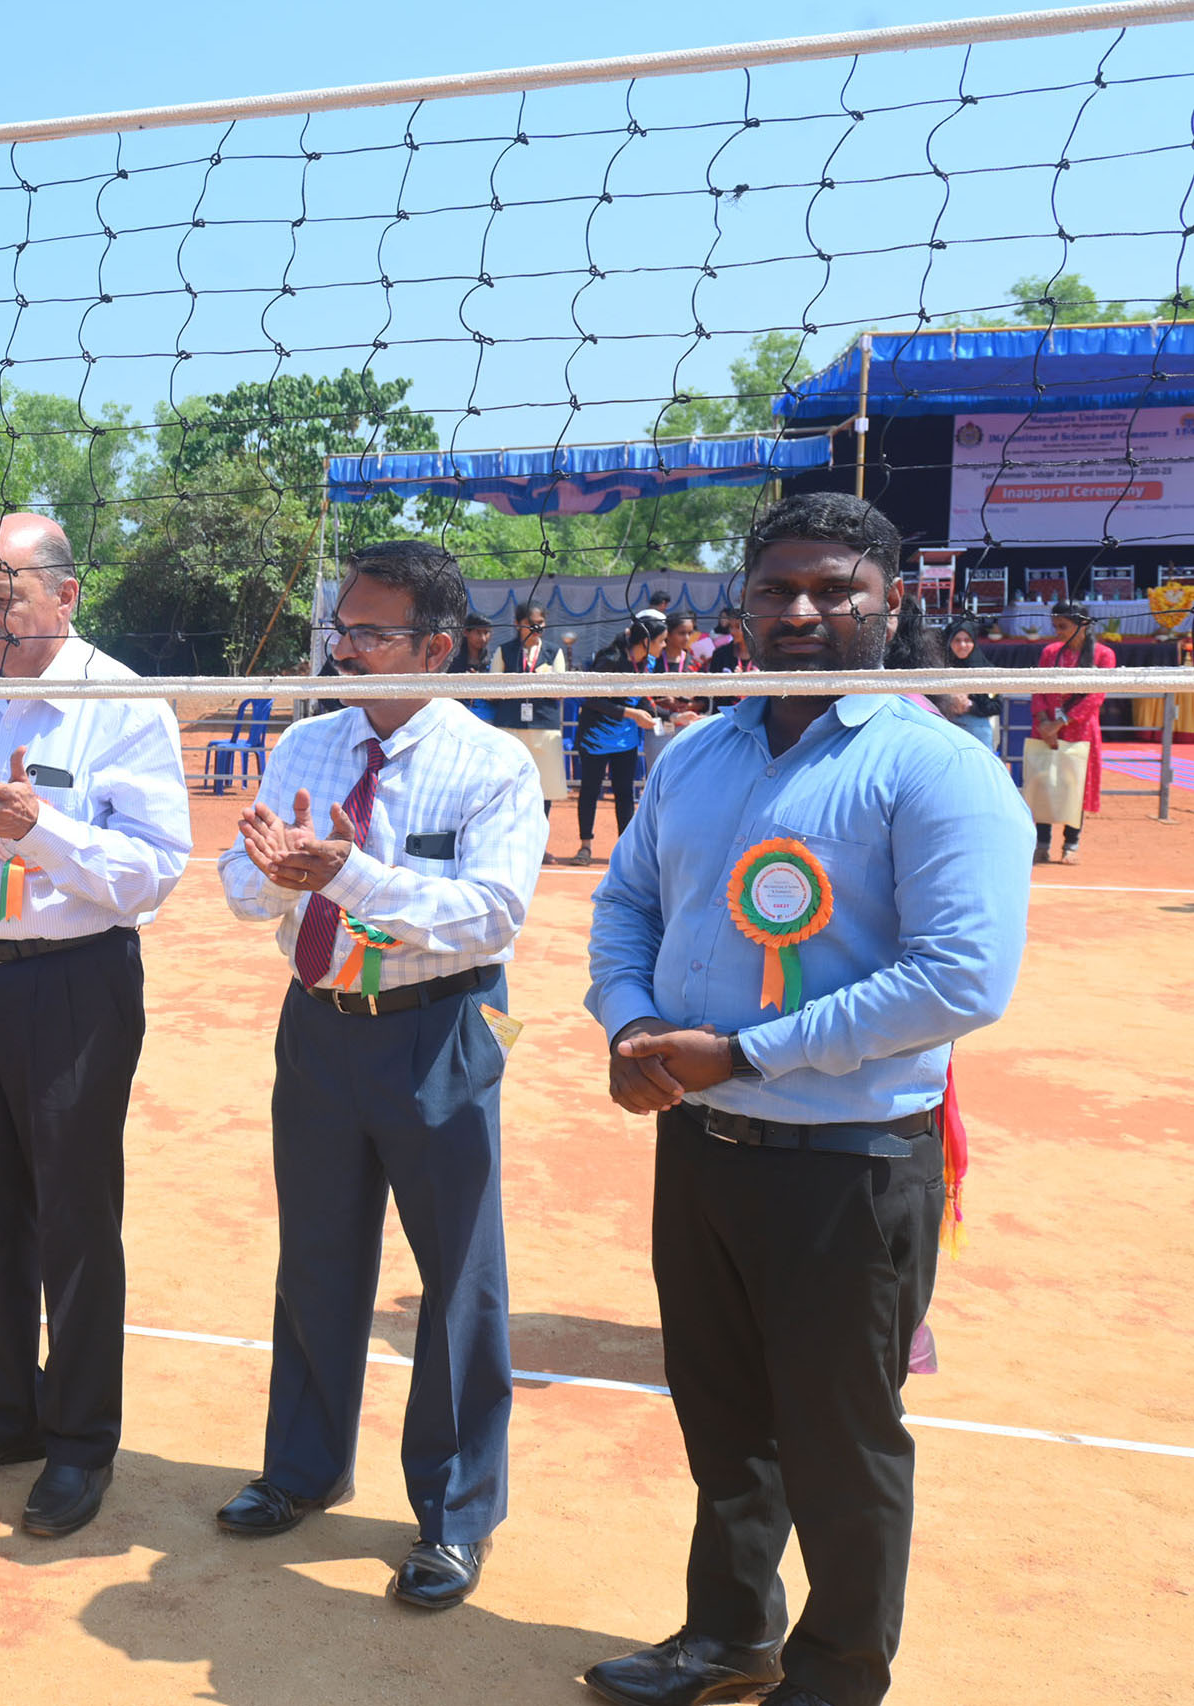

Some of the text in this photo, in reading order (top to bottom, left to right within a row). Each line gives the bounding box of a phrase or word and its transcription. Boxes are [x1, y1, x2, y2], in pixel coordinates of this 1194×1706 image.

[1079, 412, 1127, 422] University
[1008, 433, 1047, 442] nstitute
[1050, 432, 1059, 441] of
[1061, 432, 1096, 440] Science
[1100, 431, 1117, 439] and
[1003, 485, 1145, 500] Inaugural Ceremony
